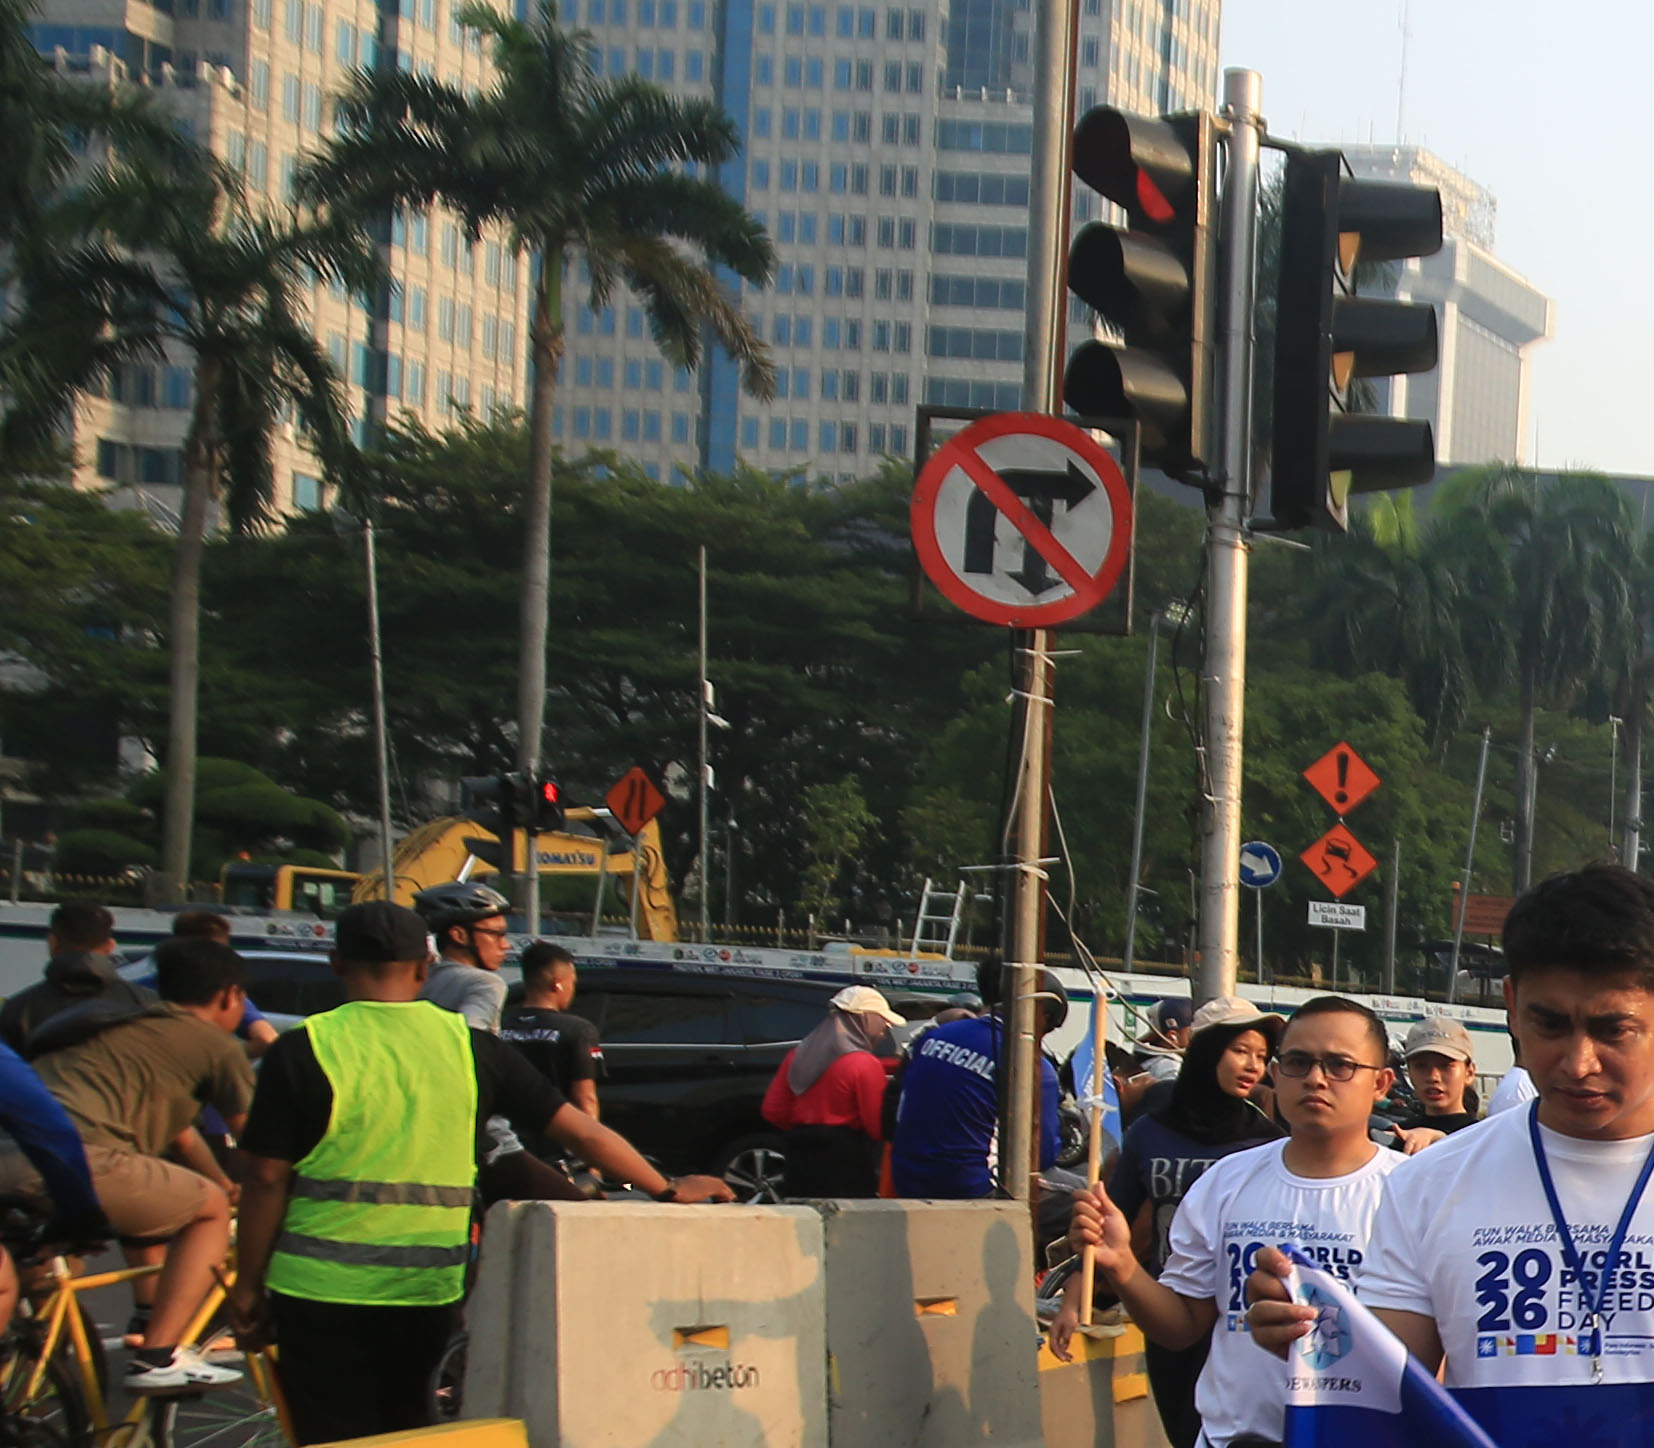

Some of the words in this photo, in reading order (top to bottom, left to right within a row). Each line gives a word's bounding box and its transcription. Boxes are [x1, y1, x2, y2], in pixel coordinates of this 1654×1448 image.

[1313, 903, 1337, 914] Licin
[1339, 905, 1360, 917] Saat
[1321, 914, 1352, 926] Basah
[920, 1037, 996, 1080] OFFICIAL
[1473, 1226, 1504, 1238] FUN
[1504, 1224, 1545, 1236] WALK
[1473, 1234, 1511, 1247] AWAK
[1515, 1231, 1557, 1244] MEDIA
[1300, 1246, 1363, 1265] ORLD
[1475, 1247, 1553, 1293] 20
[1475, 1287, 1549, 1333] 26
[1557, 1311, 1617, 1333] DAY
[652, 1361, 762, 1391] adhibeton
